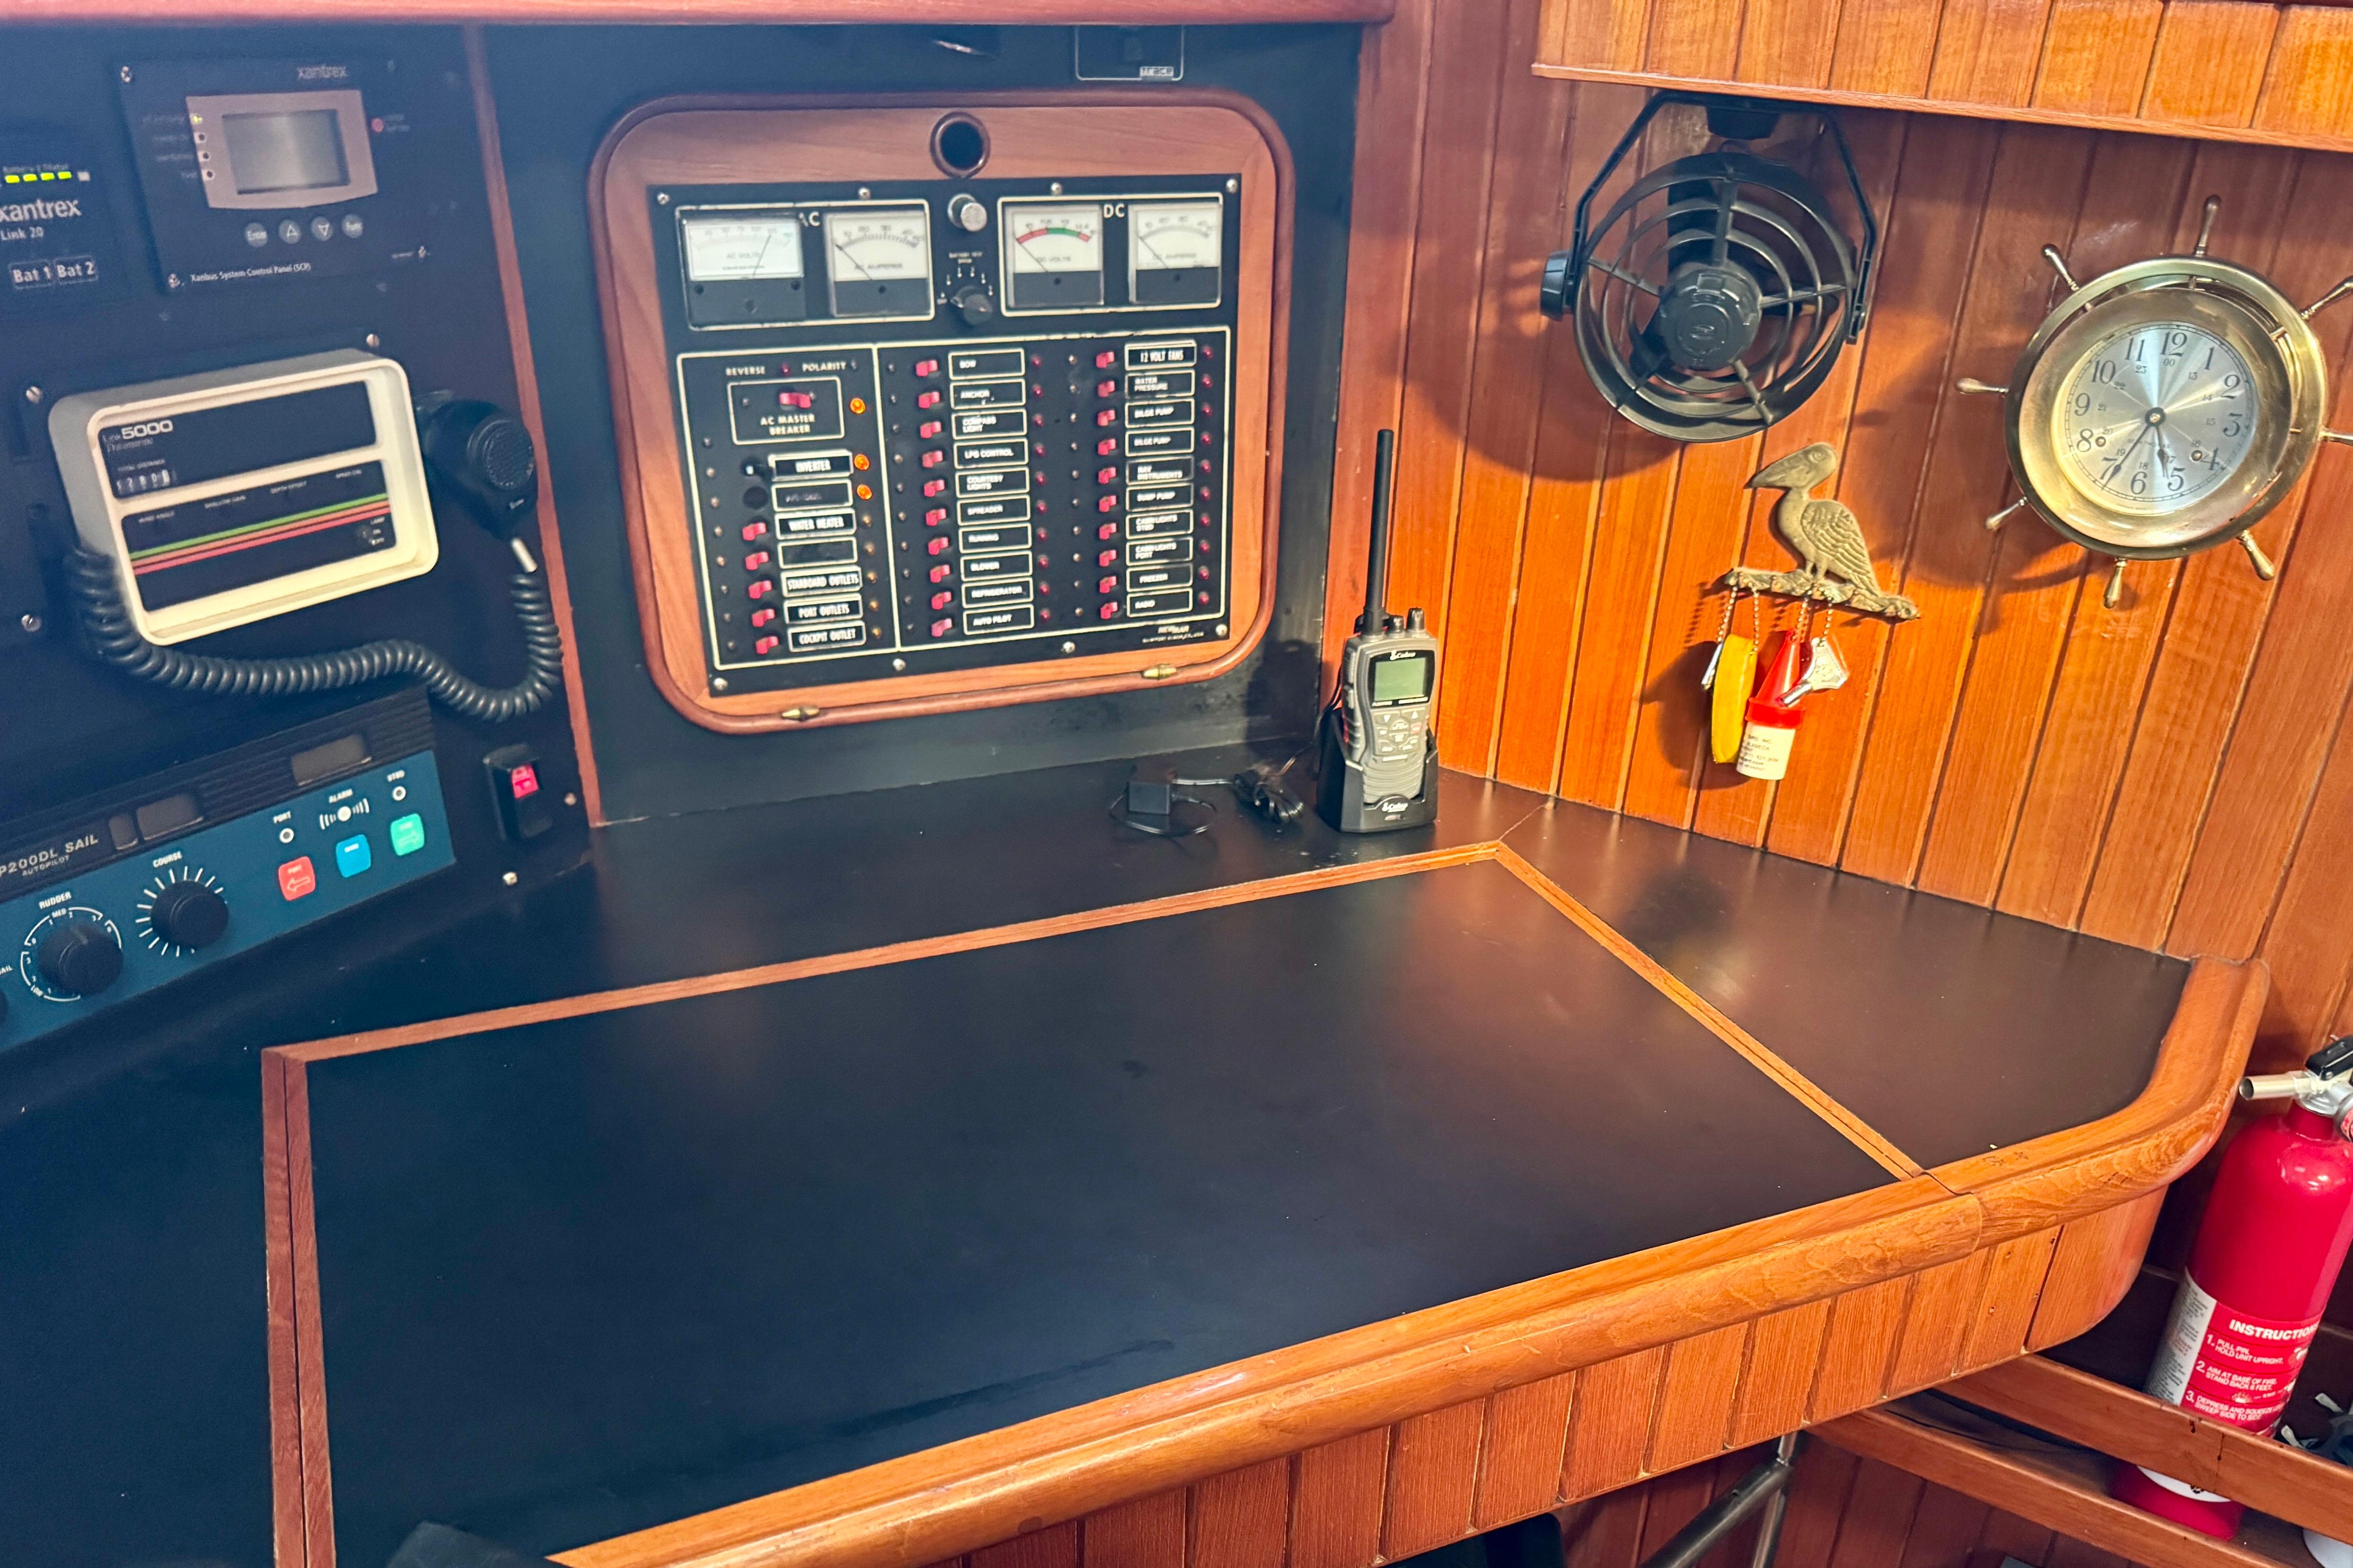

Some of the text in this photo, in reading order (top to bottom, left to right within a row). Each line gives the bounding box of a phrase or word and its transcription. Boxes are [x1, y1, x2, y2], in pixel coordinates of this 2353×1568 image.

[296, 64, 348, 80] xantrex
[0, 198, 82, 223] xantrex
[1103, 204, 1125, 218] DC
[0, 226, 44, 240] Link 20
[13, 266, 51, 284] Bat 1
[56, 261, 95, 279] Bat 2
[219, 270, 246, 281] System
[247, 267, 273, 278] Control
[2124, 337, 2145, 362] 11
[2161, 331, 2188, 357] 12
[1149, 350, 1166, 362] VOLT
[1168, 348, 1184, 361] FANS
[2163, 358, 2175, 367] 00
[2205, 347, 2215, 370] 1
[726, 361, 847, 377] REVERSE POLARITY
[2091, 359, 2116, 385] 10
[2135, 364, 2147, 374] 23
[2188, 372, 2198, 381] 13
[2221, 374, 2240, 400] 2
[2074, 392, 2091, 416] 9
[760, 413, 815, 426] AC MASTER
[962, 415, 997, 426] COMPASS
[2206, 418, 2216, 426] 15
[2223, 413, 2243, 437] 3
[121, 419, 173, 440] 5000
[769, 424, 811, 436] BREAKER
[962, 424, 983, 434] LIGHT
[2076, 428, 2094, 452] 8
[980, 448, 1014, 458] CONTROL
[2117, 448, 2126, 457] 19
[2200, 448, 2220, 470] 4
[795, 459, 832, 473] INVERTER
[2100, 457, 2118, 480] 7
[2139, 461, 2149, 470] 18
[966, 473, 1004, 484] COURTESY
[967, 482, 992, 491] LIGHTS
[2130, 471, 2148, 495] 6
[2167, 467, 2185, 492] 5
[967, 504, 1003, 516] SPREADER
[788, 515, 844, 532] WATER HEATER
[1154, 514, 1178, 524] LIGHTS
[1154, 542, 1177, 551] LIGHTS
[970, 561, 1000, 572] BLOWER
[787, 573, 859, 591] STARBOARD OUTLETS
[971, 585, 1023, 598] REFRIGERATOR
[798, 603, 850, 619] PORT OUTLETS
[972, 614, 1013, 627] AUTO PILOT
[799, 627, 856, 645] COCKPIT OUTLET
[328, 788, 353, 804] ALARM
[273, 810, 291, 824] PORT
[65, 834, 99, 853] SAIL
[23, 855, 71, 876] AUTOPILOT
[153, 851, 183, 868] COURSE
[38, 891, 72, 909] RUDDER
[51, 908, 67, 918] MED
[2206, 1334, 2215, 1347] 1.
[2217, 1338, 2234, 1351] PULL
[2235, 1346, 2250, 1355] PIN.
[2215, 1345, 2284, 1365] HOLD UNIT UPRIGHT.
[2206, 1372, 2229, 1385] STAND
[2229, 1379, 2249, 1390] BACK
[2207, 1366, 2221, 1375] AIM
[2232, 1374, 2252, 1383] BASE
[2185, 1390, 2195, 1403] 3.
[2196, 1395, 2229, 1411] DEPRESS
[2194, 1401, 2219, 1414] SWEEP
[2219, 1411, 2236, 1420] SIDE
[2237, 1413, 2248, 1421] TO
